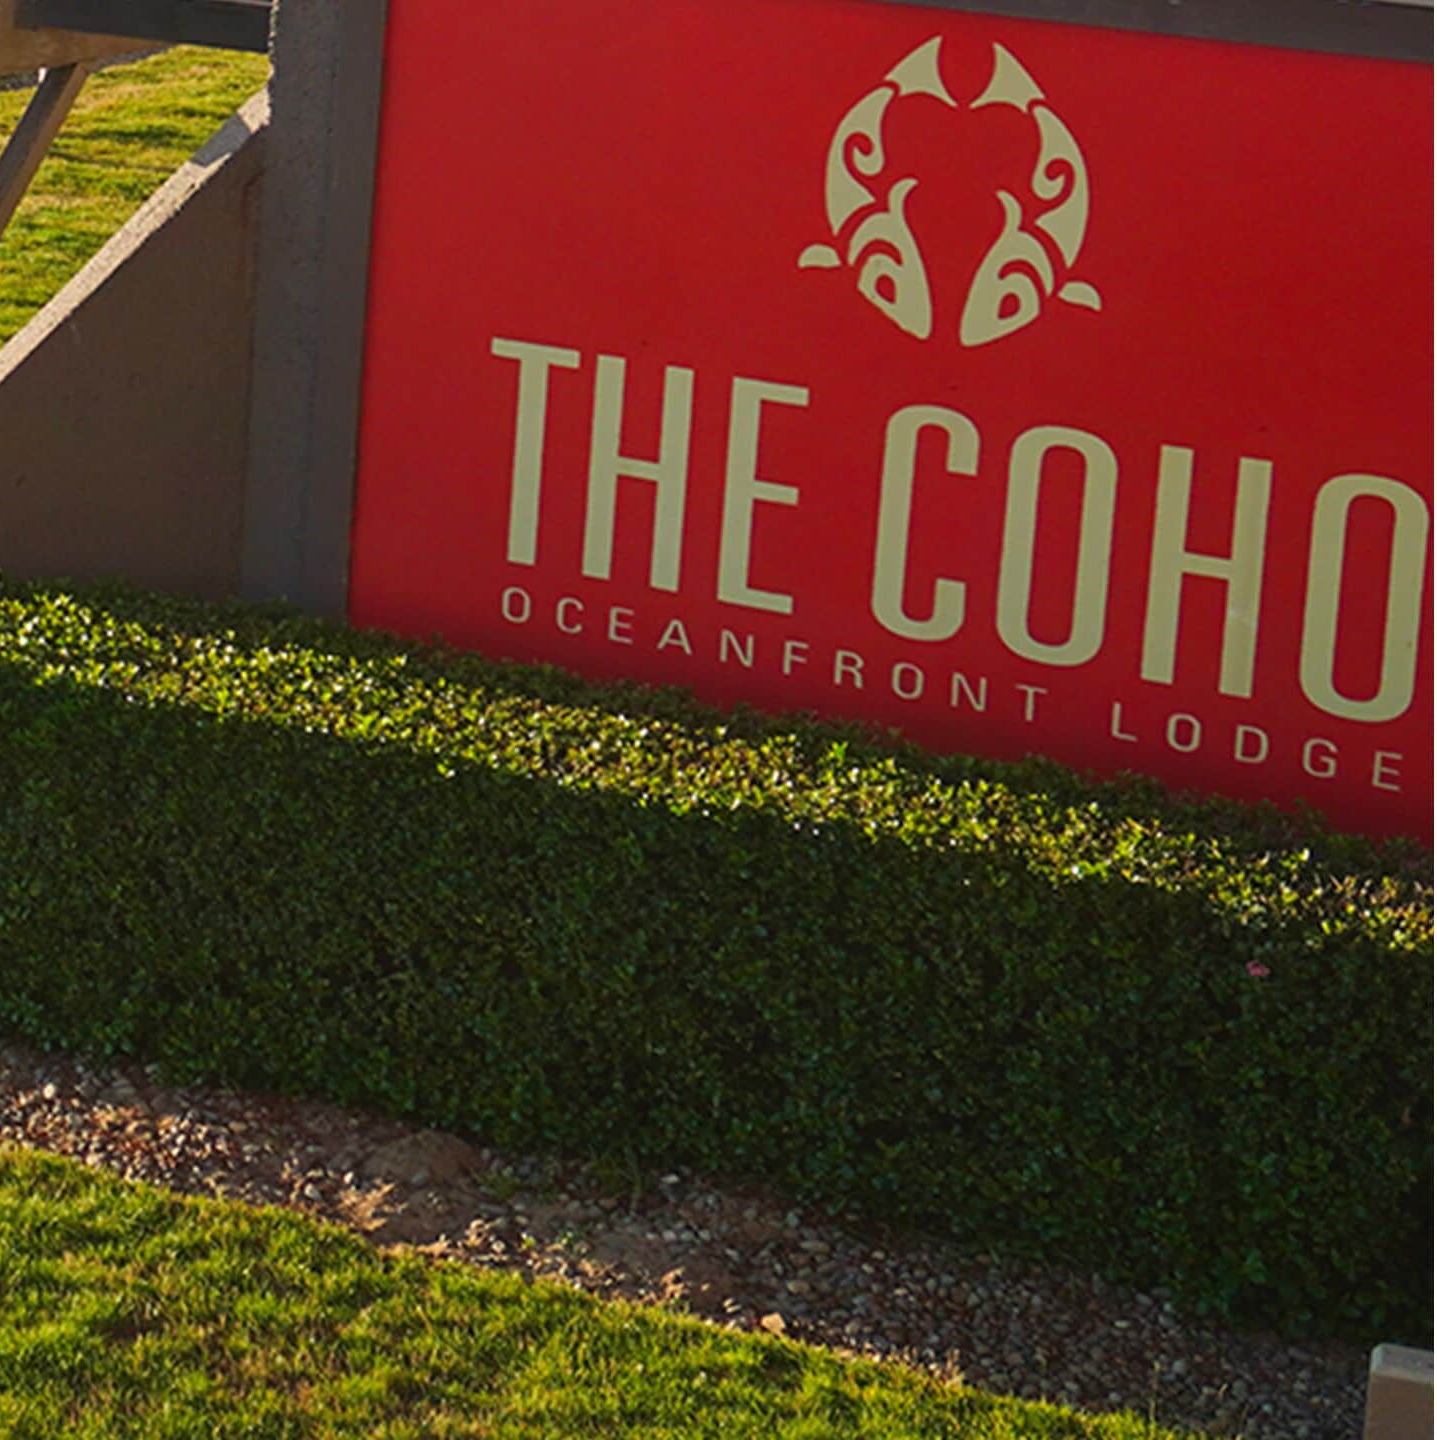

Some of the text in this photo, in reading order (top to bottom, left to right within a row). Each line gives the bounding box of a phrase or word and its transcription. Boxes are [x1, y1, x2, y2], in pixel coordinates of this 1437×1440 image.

[491, 337, 1430, 723] THE COHO
[501, 587, 1403, 791] OCEANFRONT LODGE
